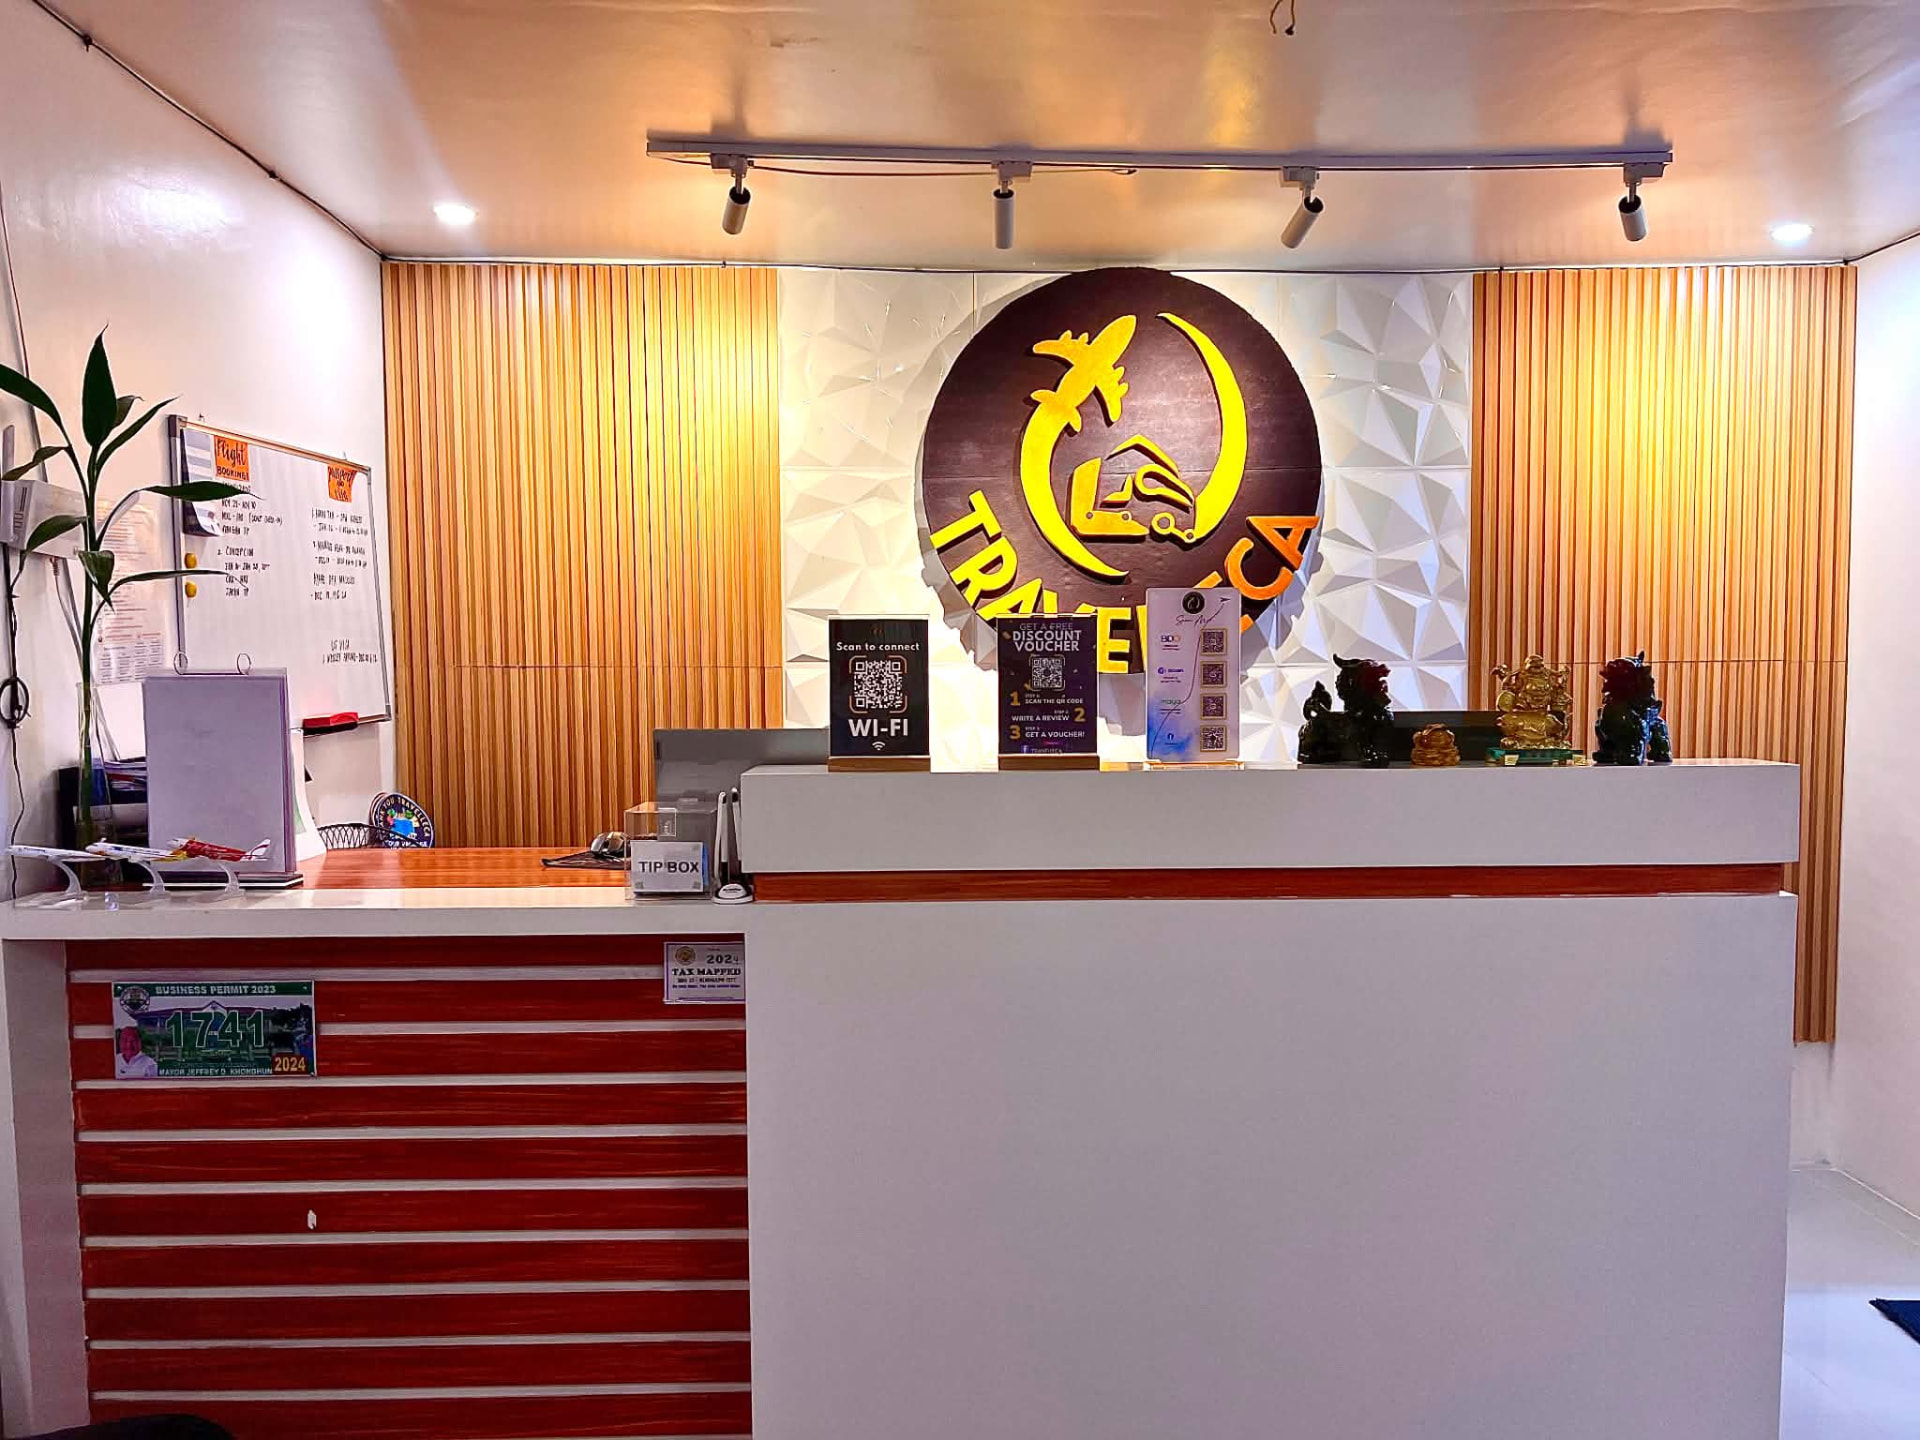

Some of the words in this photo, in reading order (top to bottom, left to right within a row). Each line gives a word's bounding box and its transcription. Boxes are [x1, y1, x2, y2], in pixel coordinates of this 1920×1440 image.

[930, 490, 1319, 674] TRAECA
[1019, 622, 1038, 631] GET
[1040, 622, 1048, 631] A
[1049, 622, 1073, 631] FREE
[1012, 630, 1082, 641] DISCOUNT
[836, 641, 862, 651] Scan
[865, 642, 876, 651] to
[878, 642, 920, 651] connect
[1014, 640, 1080, 652] VOUCHER
[1010, 691, 1021, 706] 1
[1074, 707, 1086, 722] 2
[848, 718, 909, 737] WI-FI
[1009, 724, 1021, 740] 3
[638, 861, 663, 873] TIP
[667, 861, 699, 873] BOX
[672, 968, 695, 976] TAX
[155, 985, 208, 995] BUSINESS
[210, 985, 250, 995] PERMIT
[251, 985, 277, 995] 2023
[165, 1009, 265, 1048] 1741
[274, 1056, 306, 1072] 2024
[159, 1068, 185, 1076] MAYOR
[187, 1068, 218, 1076] JEFFREY
